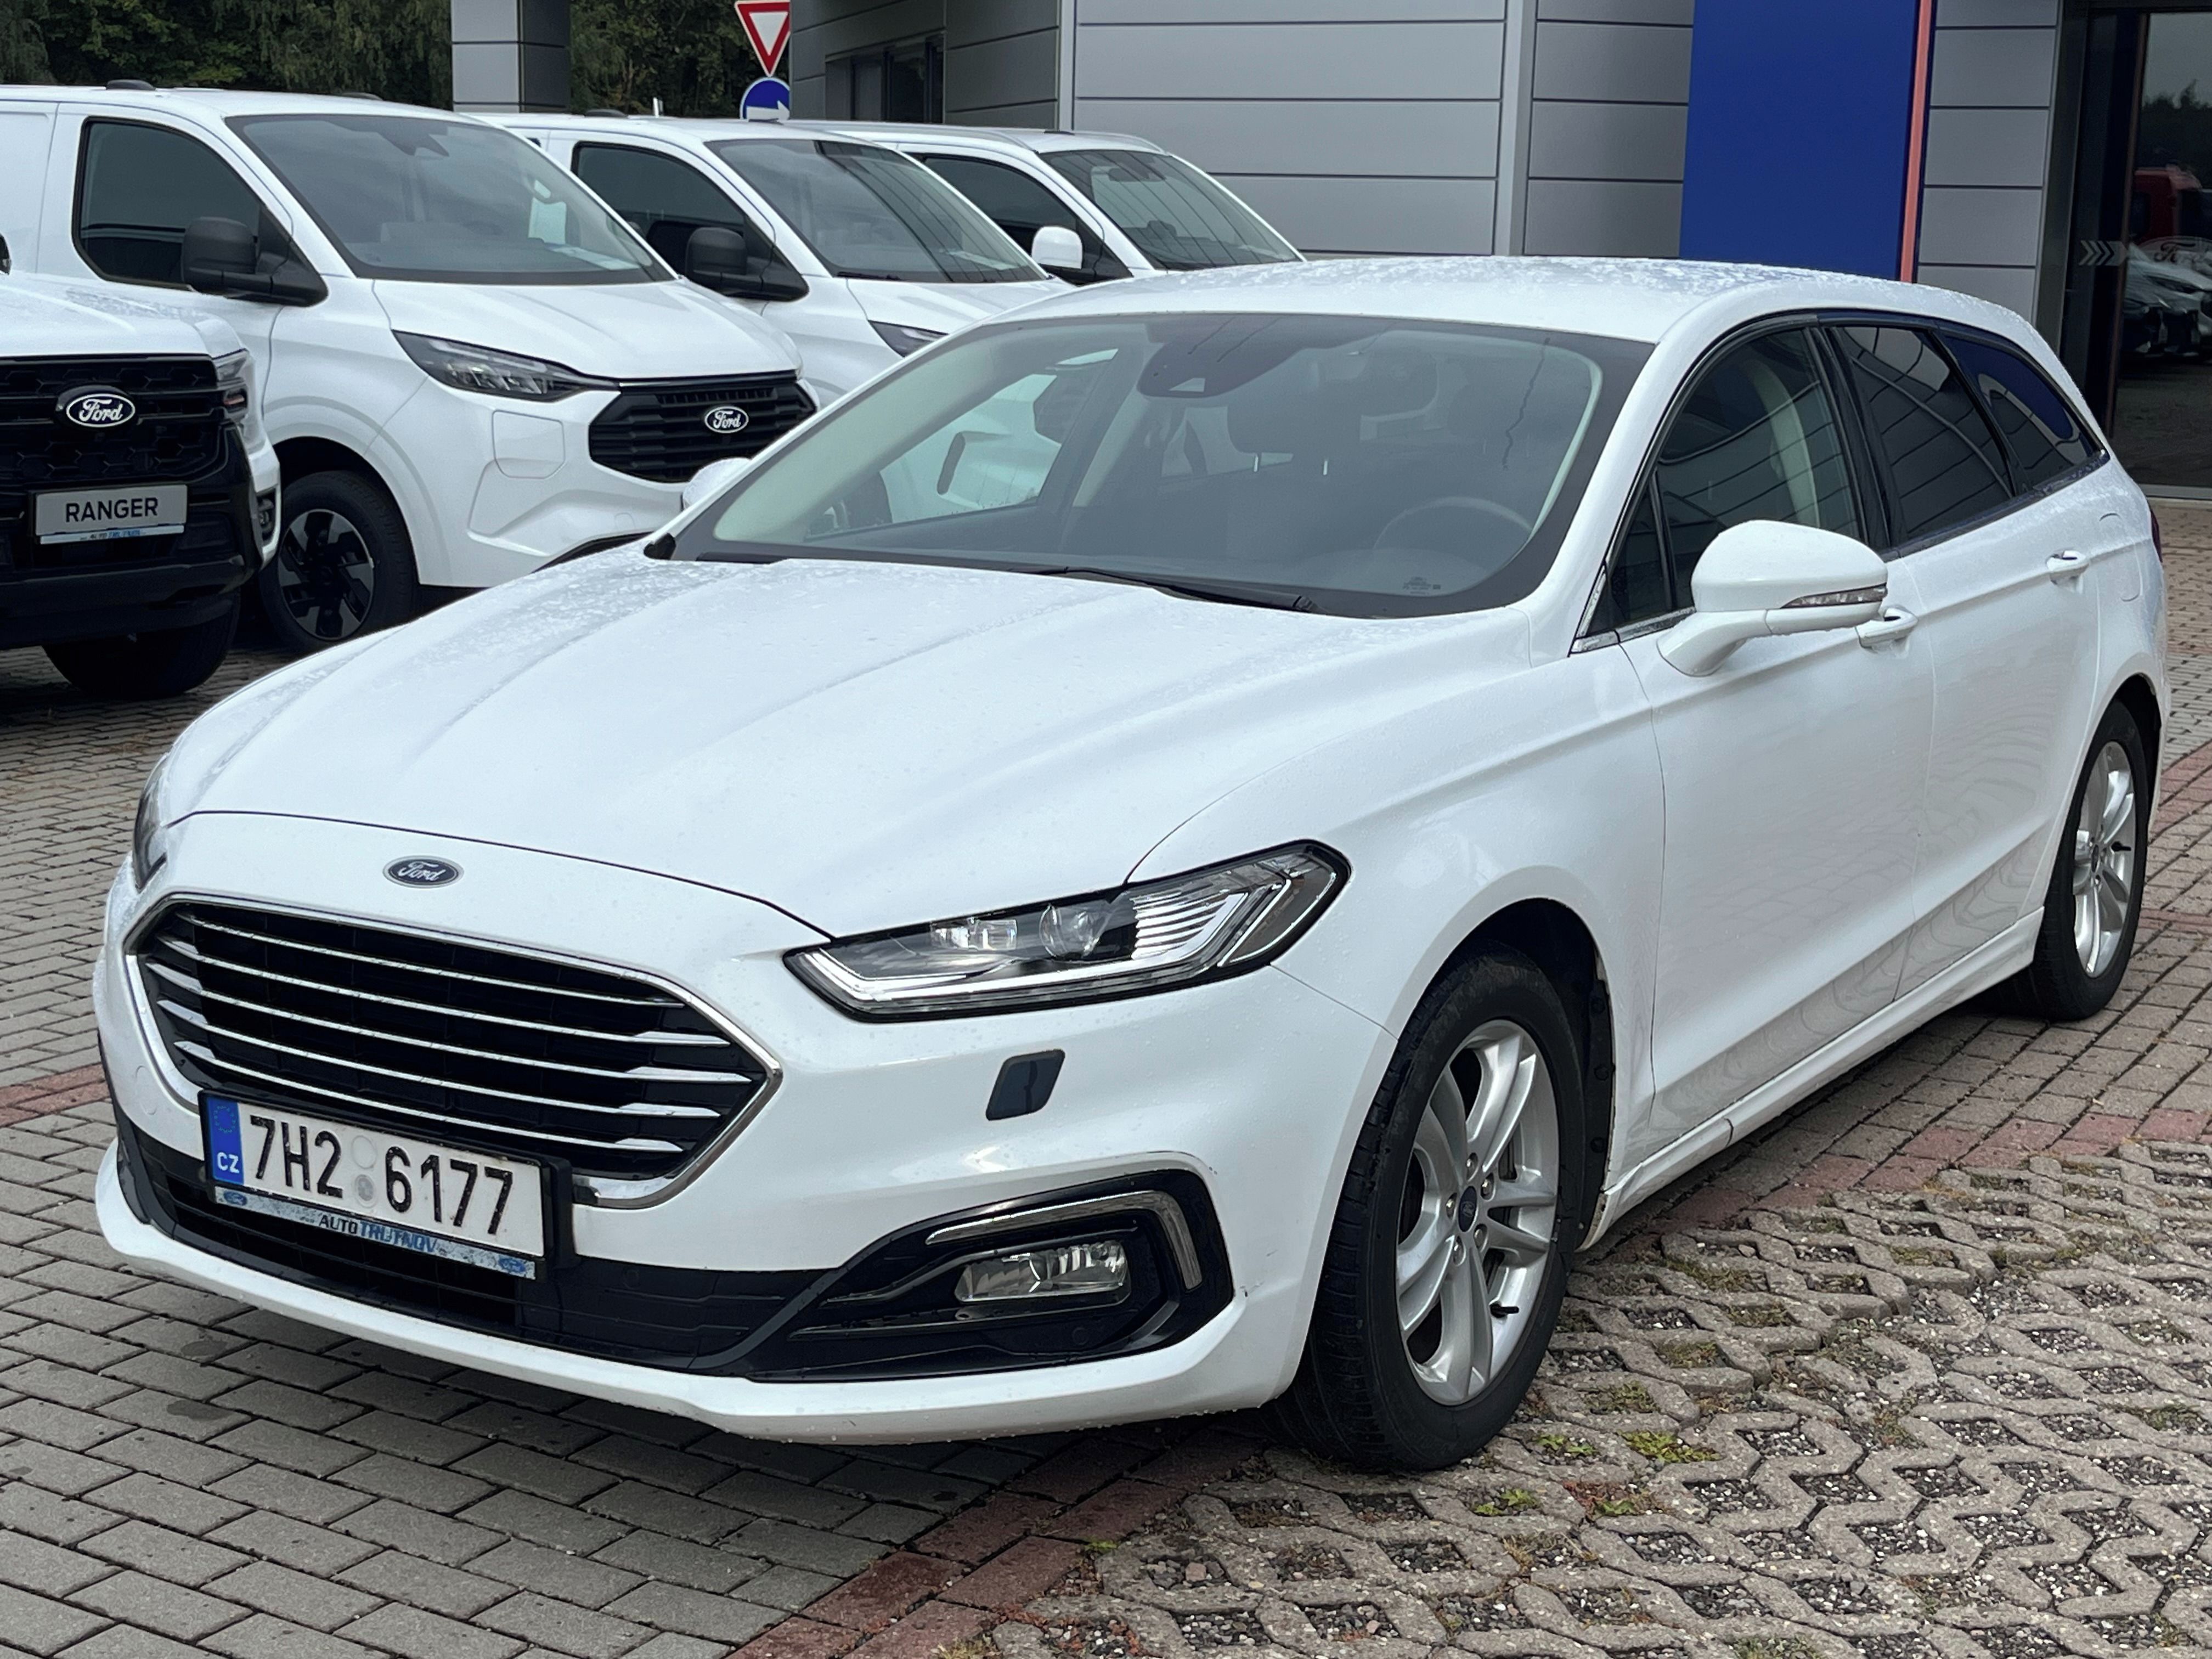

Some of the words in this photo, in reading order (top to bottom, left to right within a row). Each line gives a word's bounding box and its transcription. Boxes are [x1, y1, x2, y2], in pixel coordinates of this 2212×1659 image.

[79, 399, 123, 421] Ford
[713, 410, 741, 428] Ford
[65, 497, 159, 522] RANGER
[398, 861, 446, 881] Ford
[217, 1152, 240, 1173] CZ
[249, 1114, 343, 1199] 7H2
[385, 1146, 514, 1235] 6177
